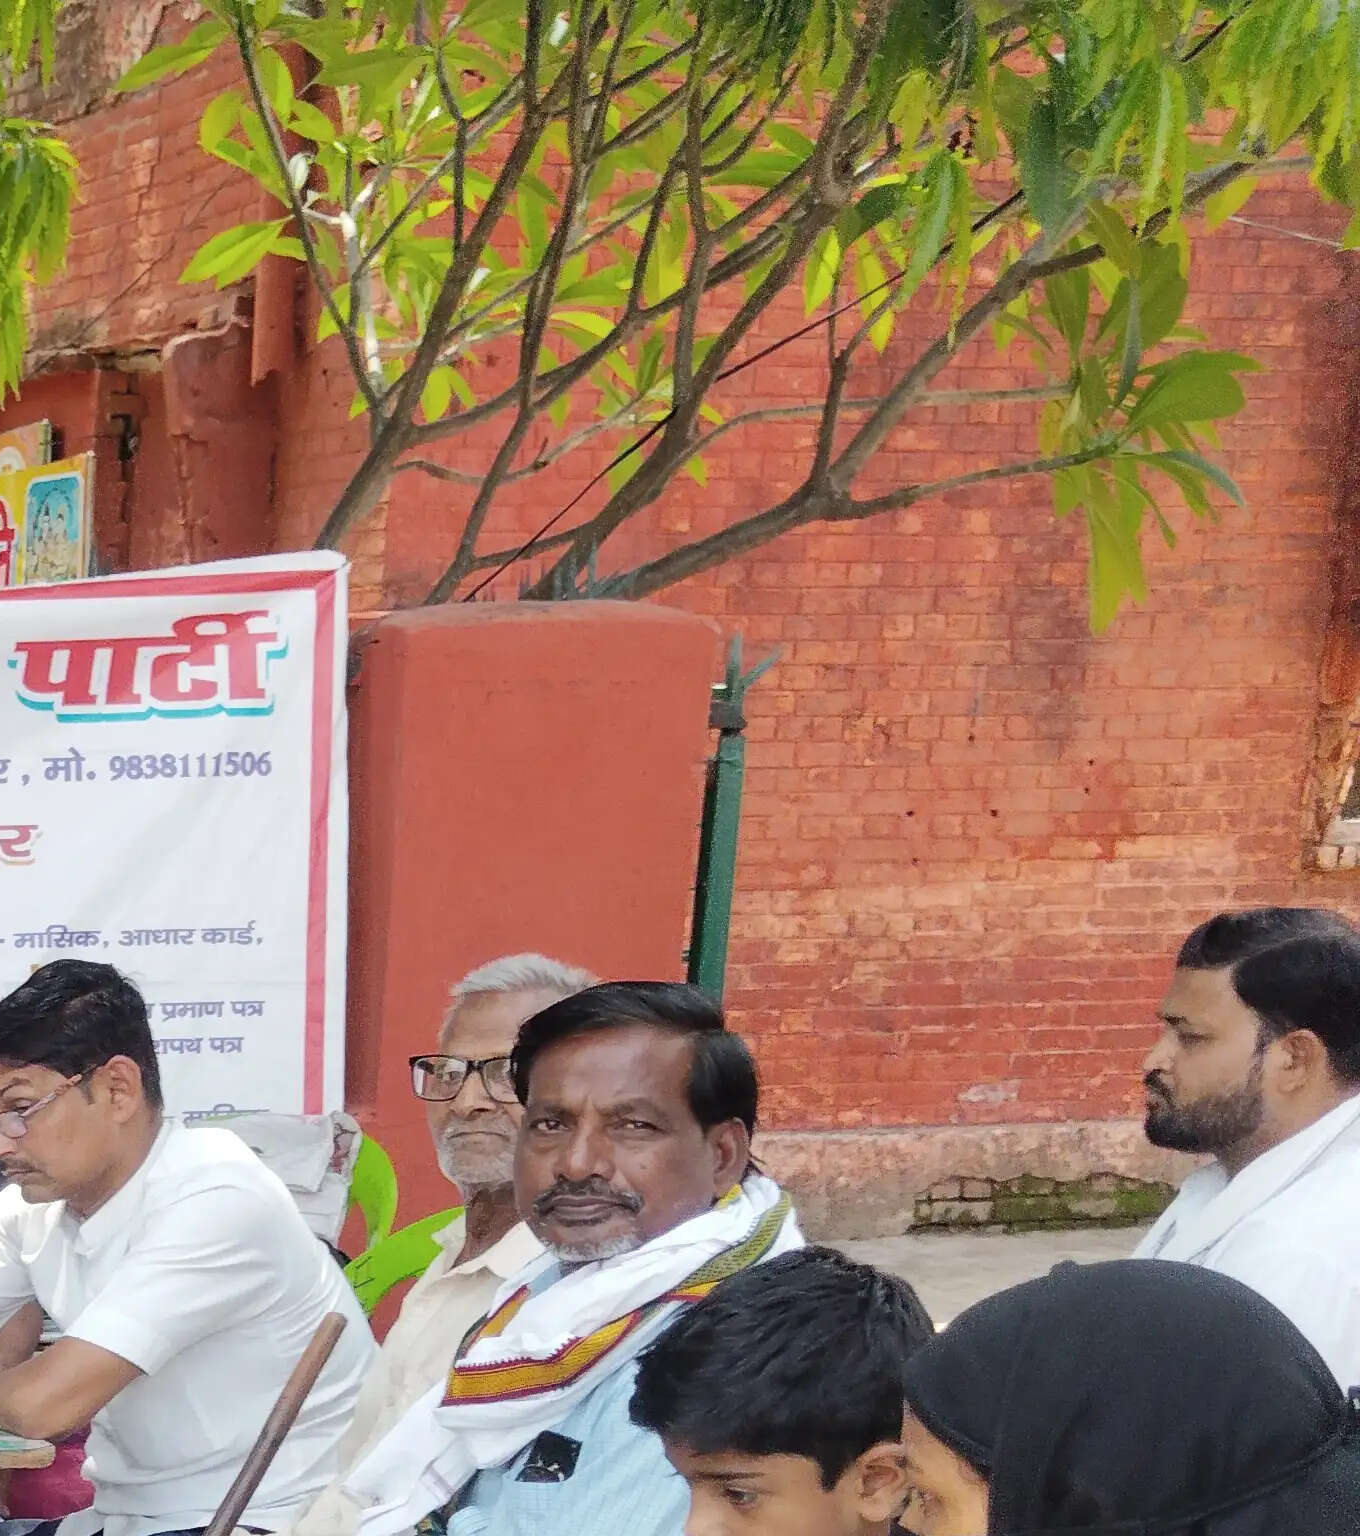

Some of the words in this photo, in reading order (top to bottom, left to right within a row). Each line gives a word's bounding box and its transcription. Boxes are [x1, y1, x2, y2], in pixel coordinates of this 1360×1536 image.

[14, 610, 279, 708] पार्टी
[43, 748, 98, 783] मो.
[109, 751, 273, 782] 9838111506
[13, 925, 109, 949] मासिक,
[118, 928, 196, 946] आधार
[200, 920, 263, 946] कार्ड,
[160, 1001, 225, 1022] प्रमाण
[231, 1000, 265, 1017] पत्र
[208, 1037, 245, 1053] पत्र
